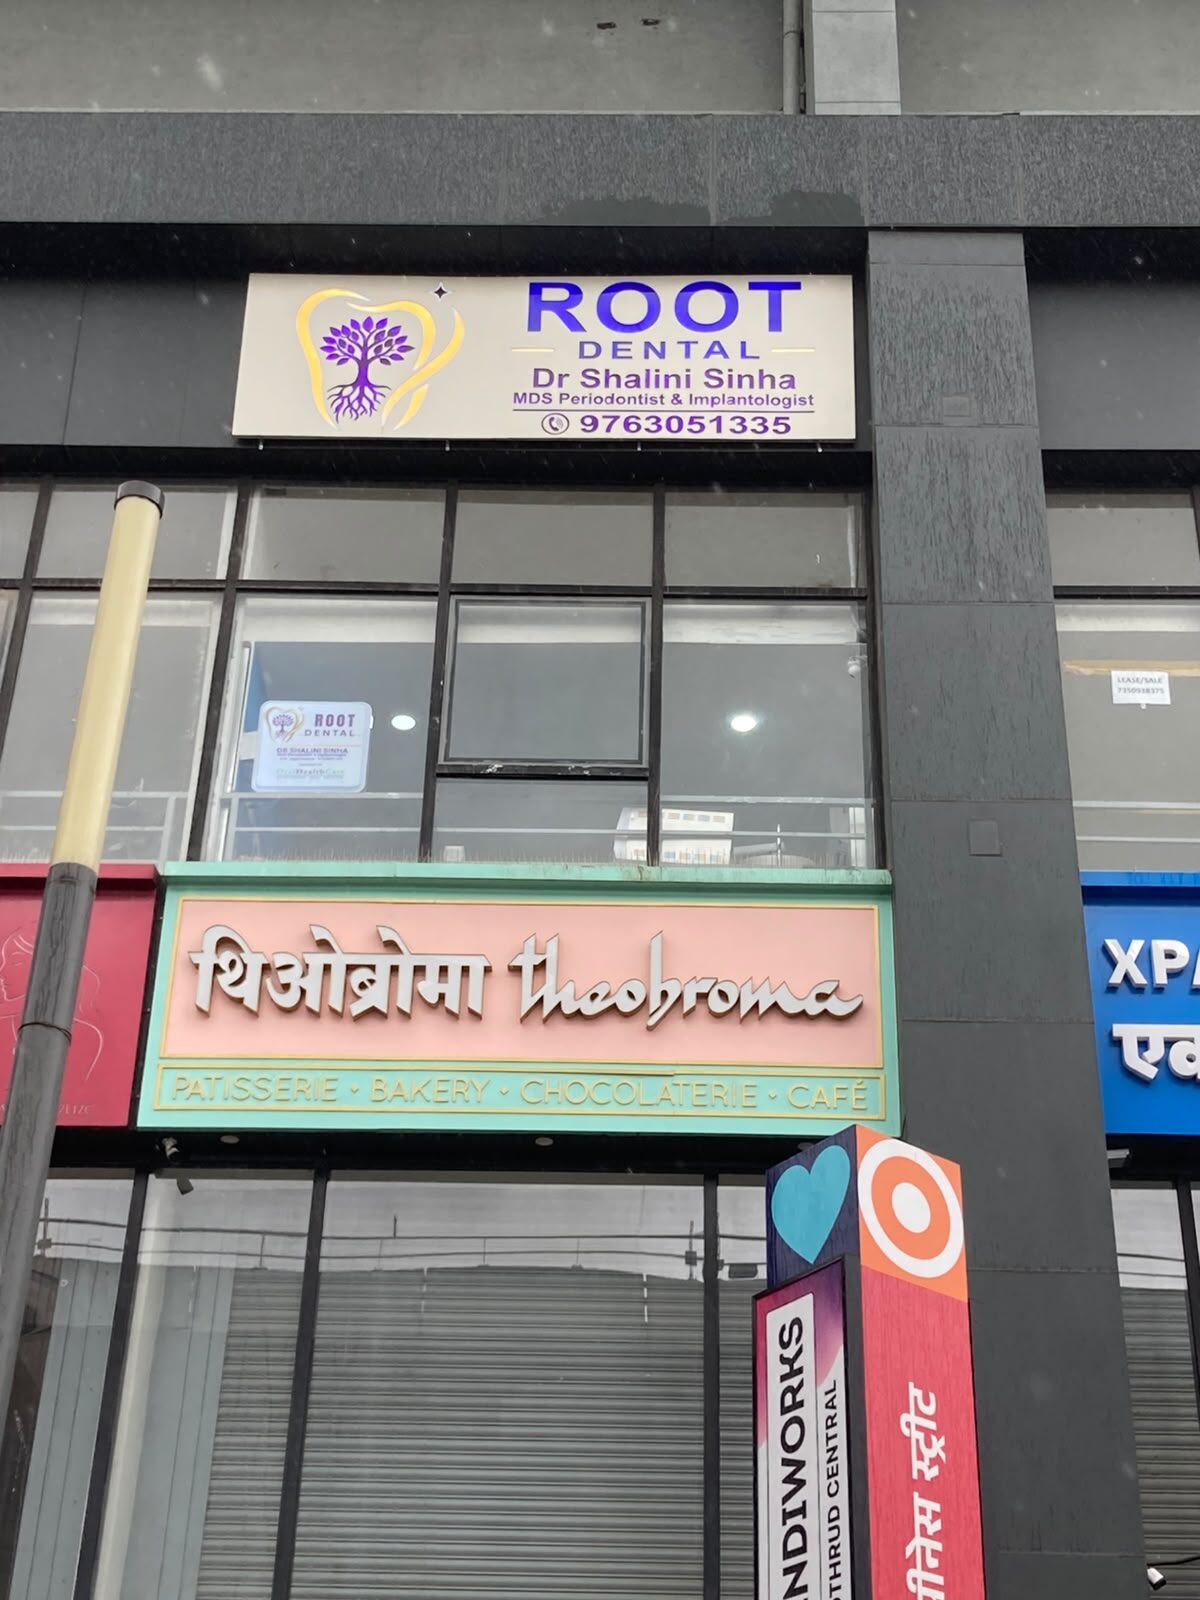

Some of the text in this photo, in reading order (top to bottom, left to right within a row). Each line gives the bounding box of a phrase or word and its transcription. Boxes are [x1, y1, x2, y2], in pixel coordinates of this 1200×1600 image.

[527, 281, 802, 333] ROOT
[578, 341, 760, 360] DENTAL
[532, 368, 796, 390] Dr Shalini Sinha
[513, 393, 815, 409] MDS Periodontist & Implantologist
[580, 415, 792, 435] 9763051335
[304, 729, 355, 737] DENTAL
[314, 713, 356, 727] ROOT
[188, 924, 492, 1022] थिओब्रोमा
[507, 930, 864, 1031] theobroma
[1103, 938, 1200, 990] XP
[172, 1074, 868, 1111] PATISSERIE BAKERY CHOCOLATERIE CAFÉ
[824, 1379, 840, 1497] CENTRAL
[778, 1317, 808, 1600] NDIWORKS
